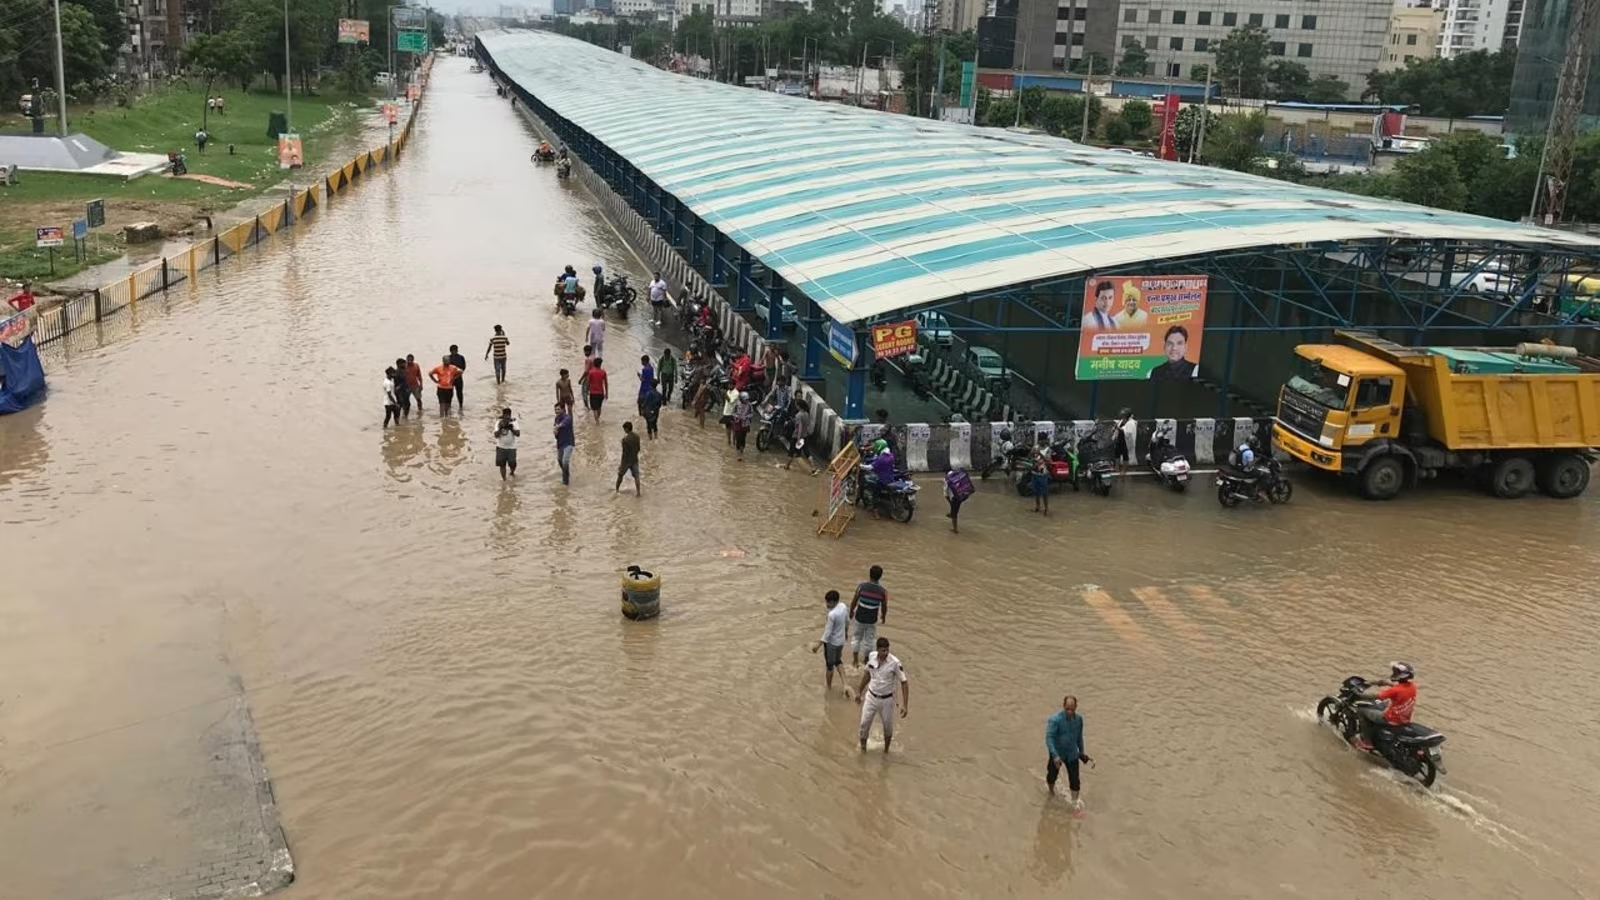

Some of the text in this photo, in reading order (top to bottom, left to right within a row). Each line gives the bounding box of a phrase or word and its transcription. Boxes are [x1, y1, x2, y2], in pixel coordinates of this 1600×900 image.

[876, 325, 912, 342] PG
[1090, 357, 1141, 369] मनीष यादव
